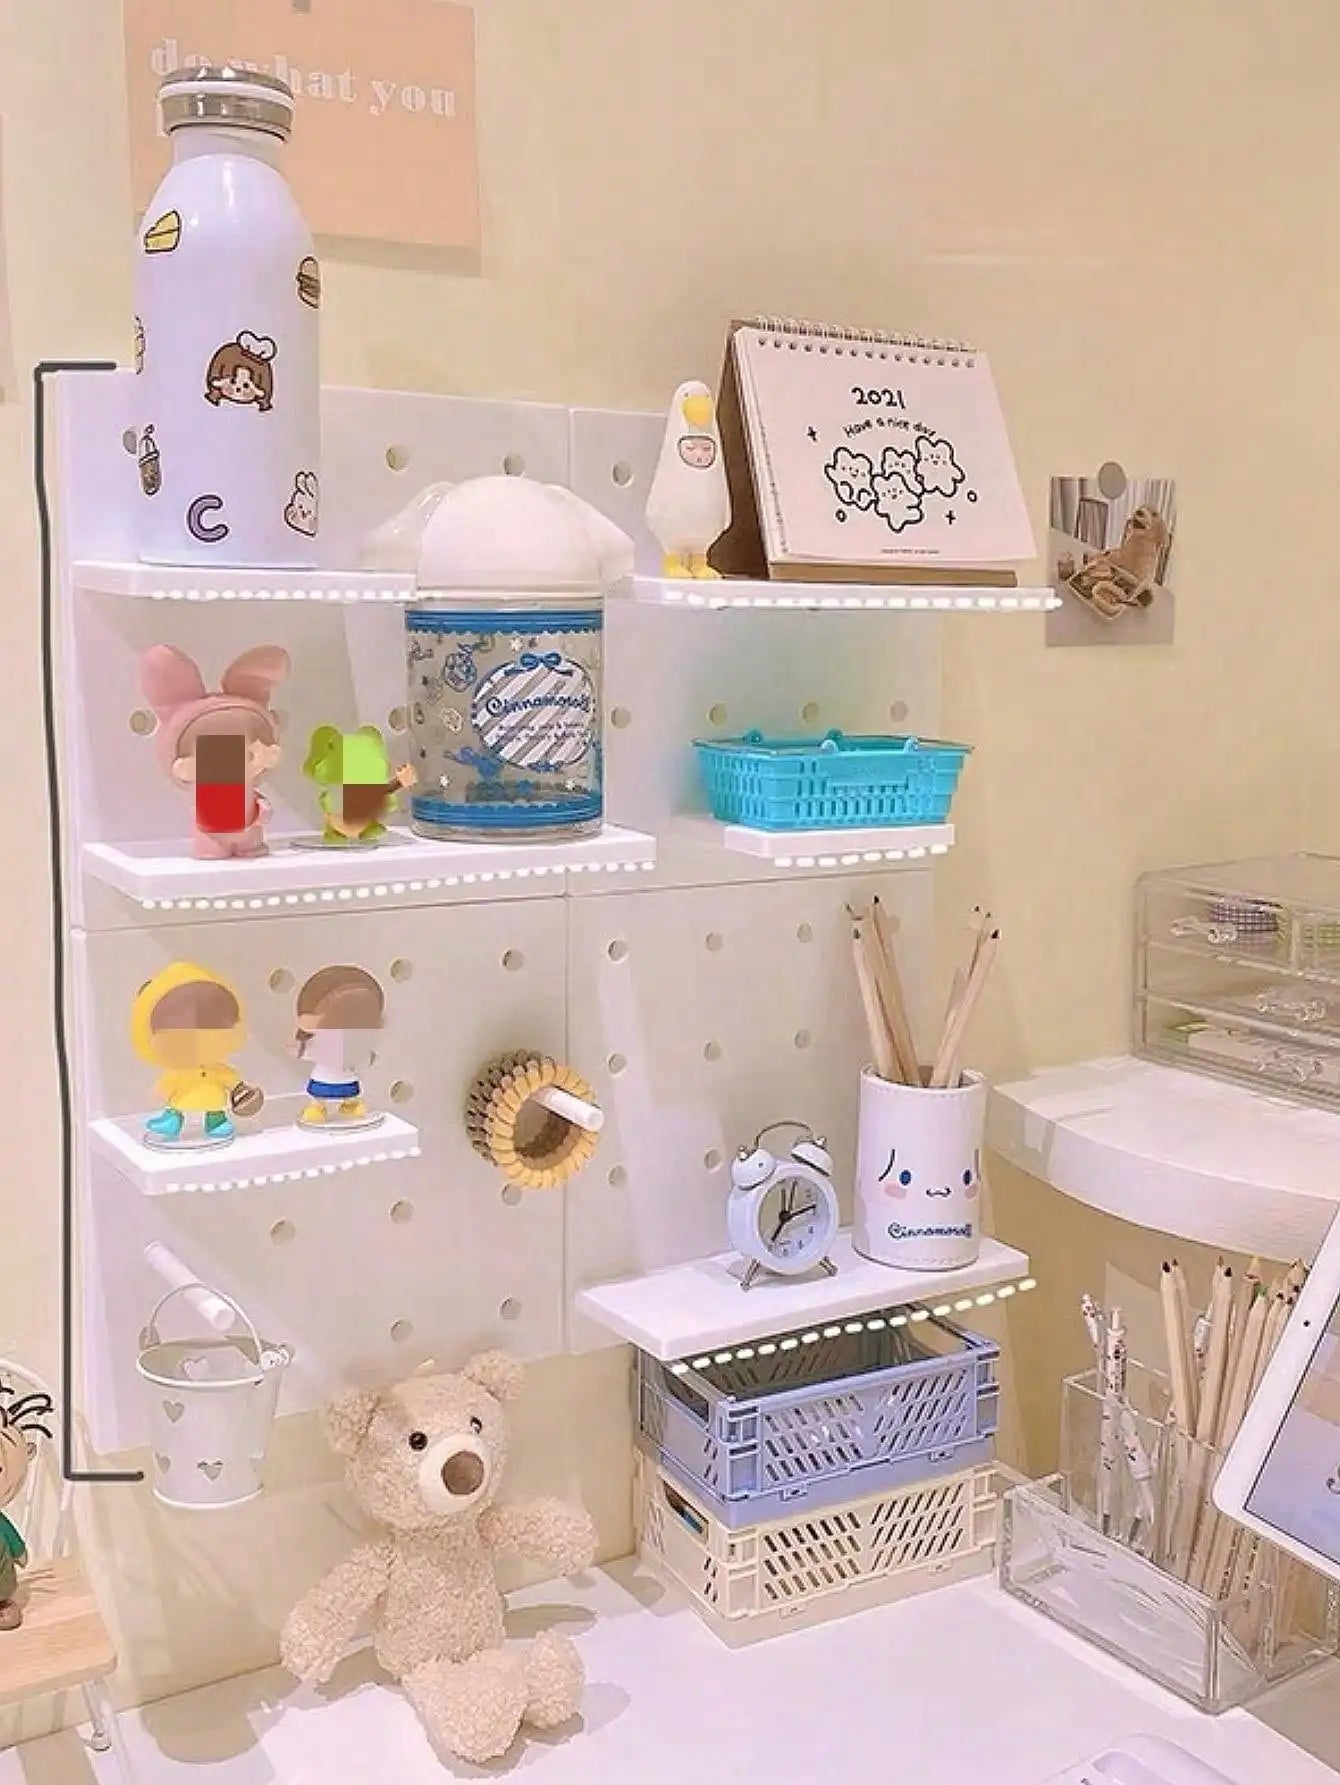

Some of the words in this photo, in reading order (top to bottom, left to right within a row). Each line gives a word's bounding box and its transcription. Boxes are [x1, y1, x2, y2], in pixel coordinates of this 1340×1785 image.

[369, 77, 457, 117] you
[851, 386, 906, 410] 2021
[842, 418, 873, 438] Have
